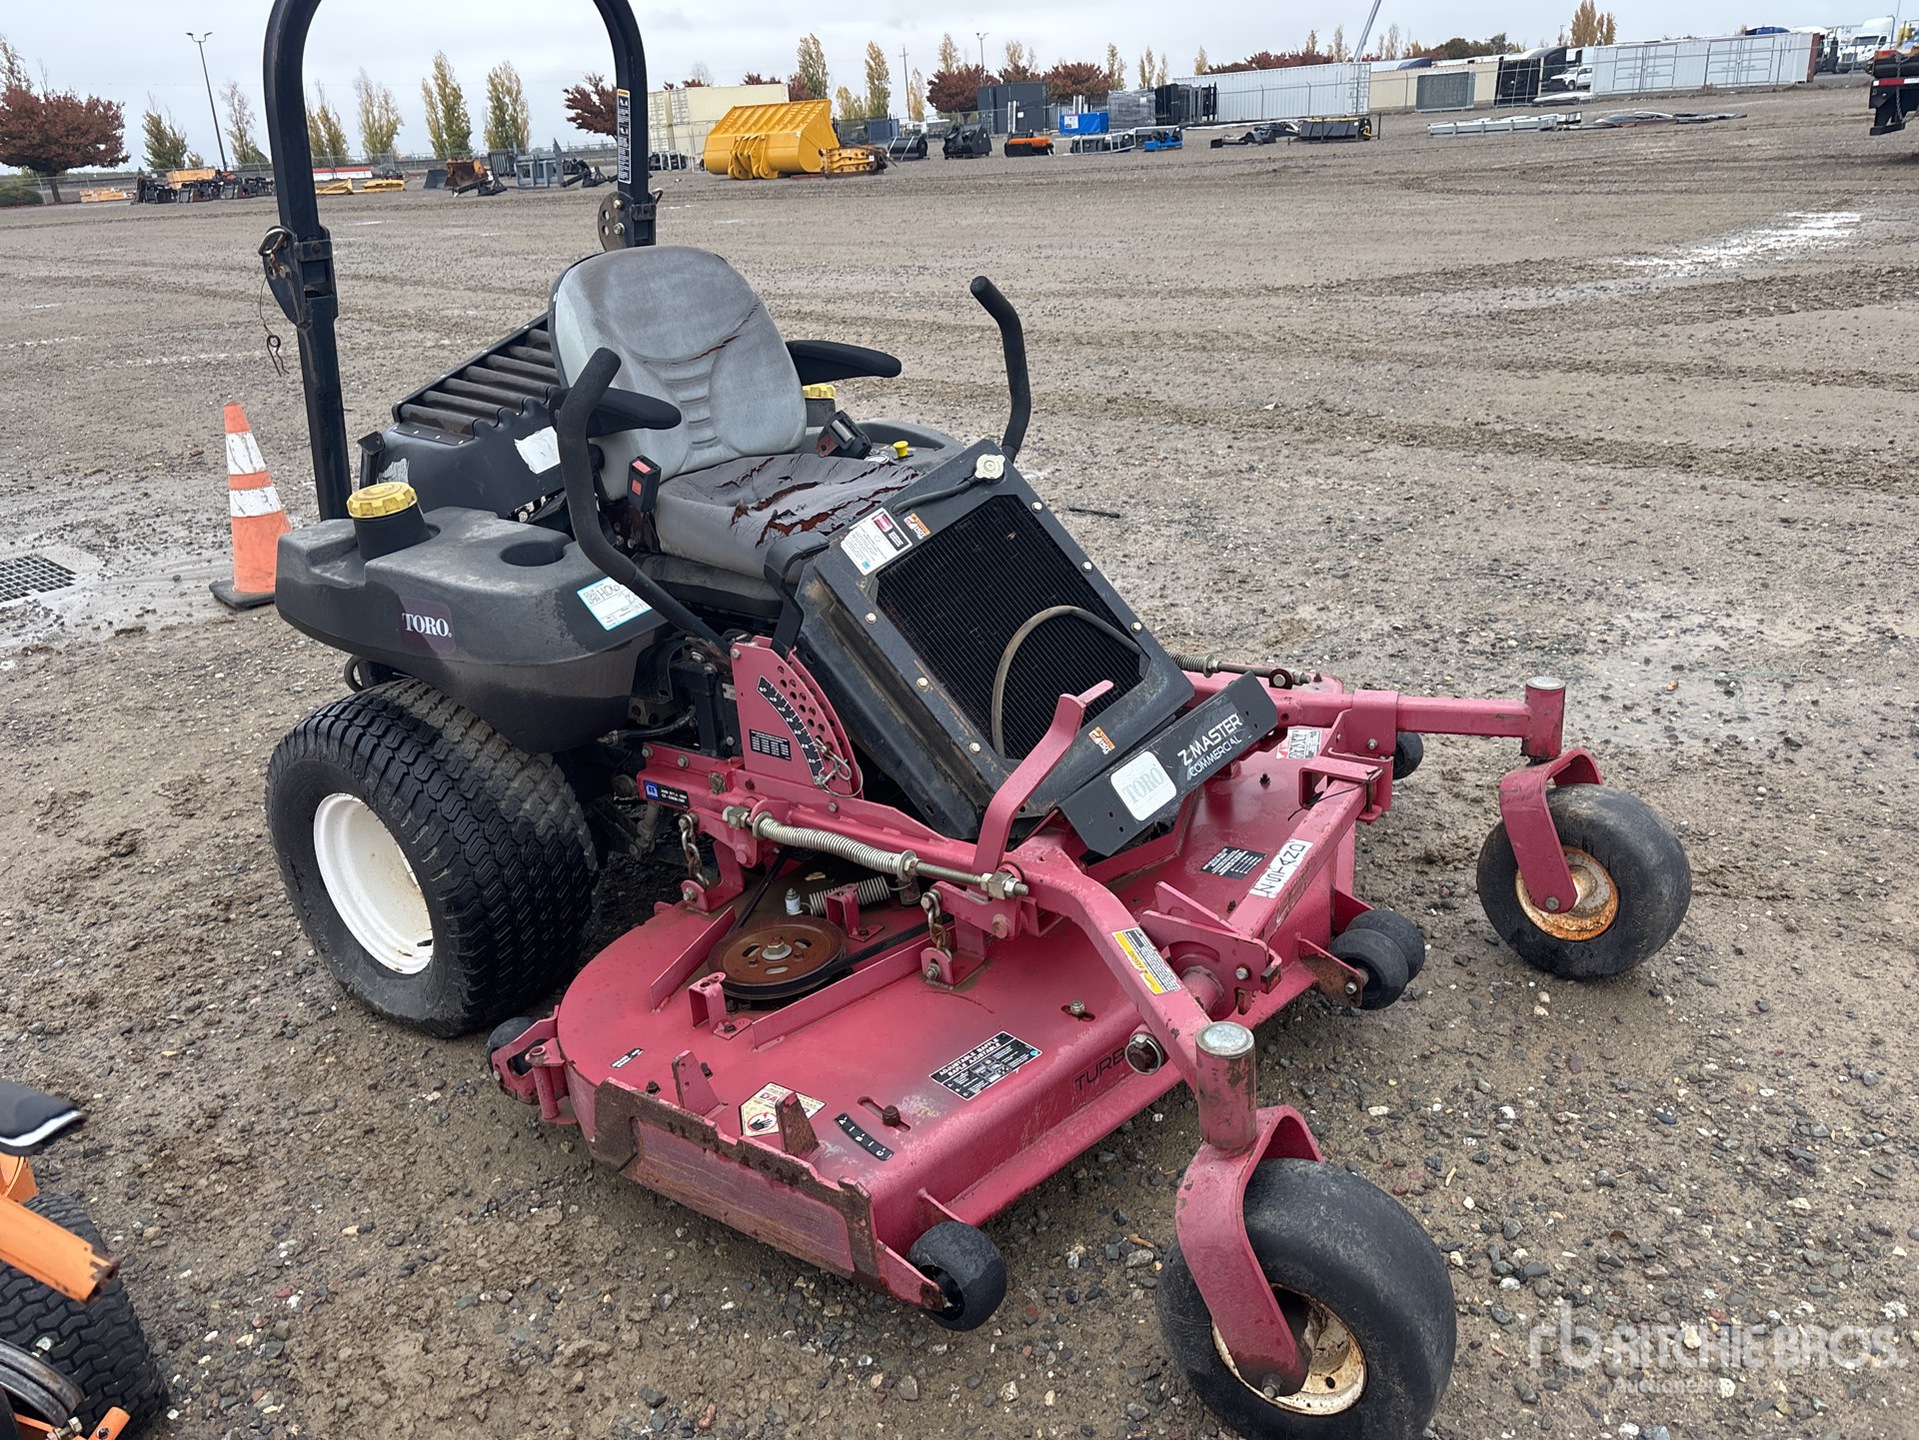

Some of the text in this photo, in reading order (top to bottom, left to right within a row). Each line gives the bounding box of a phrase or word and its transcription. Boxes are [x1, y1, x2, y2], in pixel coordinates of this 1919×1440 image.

[402, 612, 450, 637] TORO
[1188, 735, 1243, 777] COMMERCIAL
[1122, 767, 1164, 804] TORO
[939, 1051, 977, 1076] ADJUSTABLE
[1074, 1042, 1130, 1090] TURB
